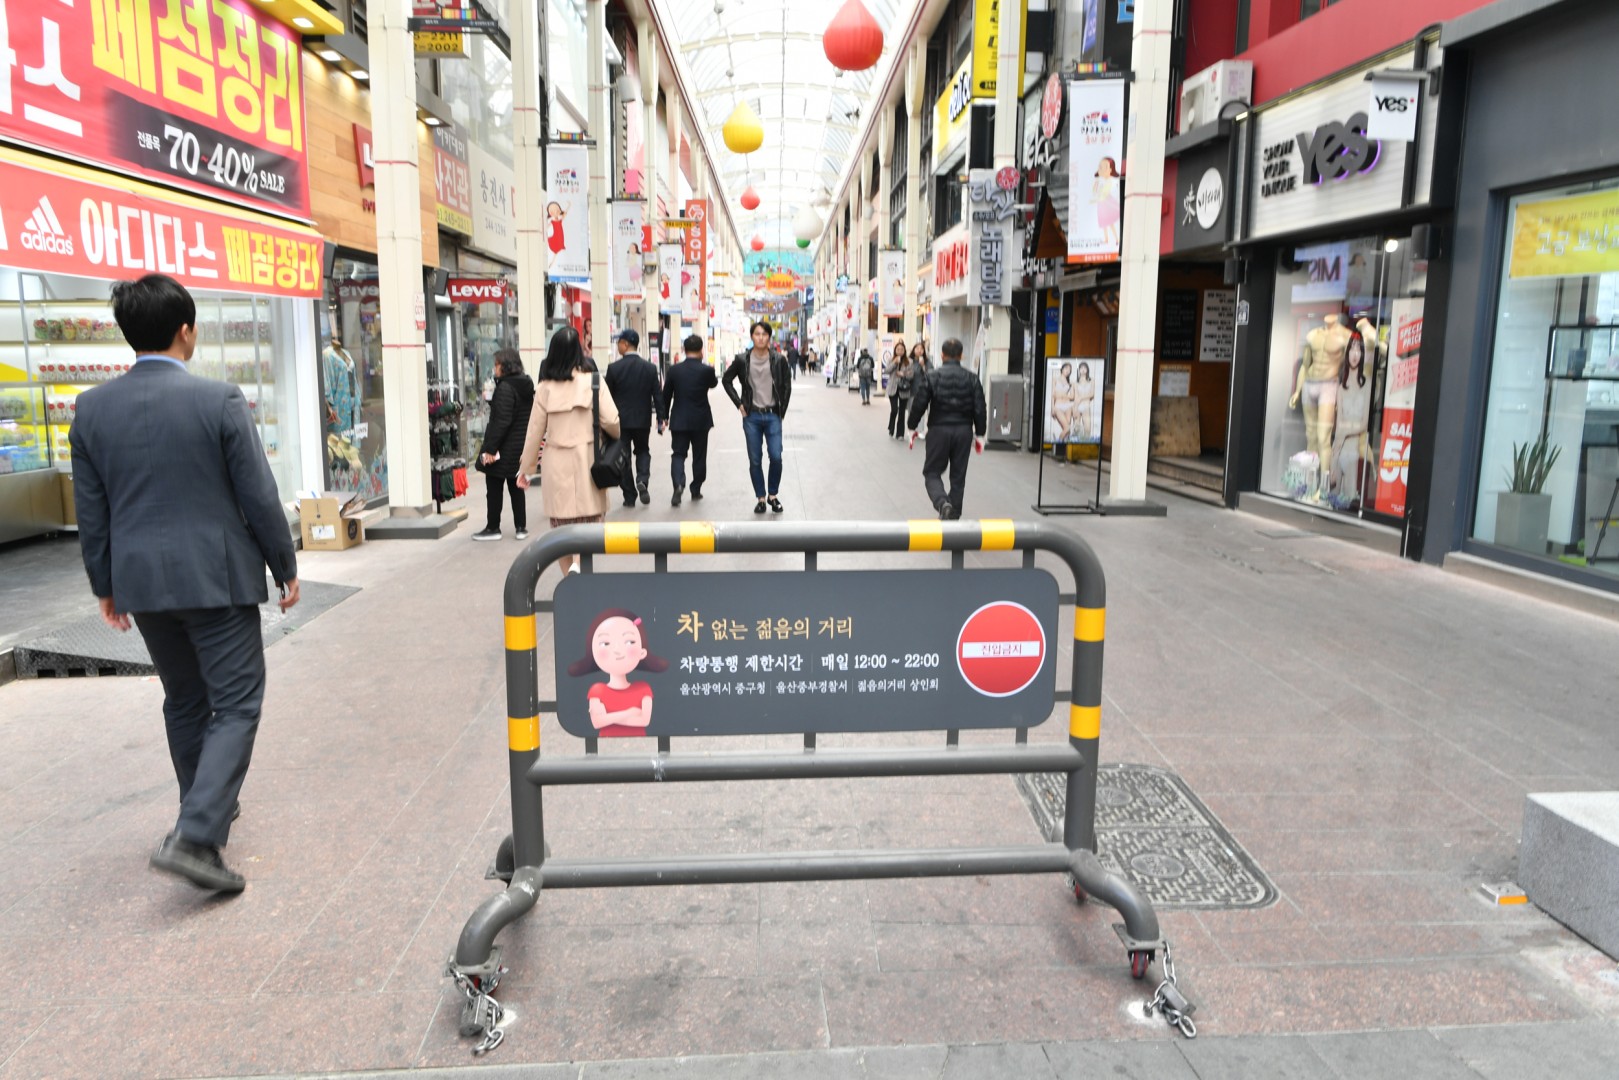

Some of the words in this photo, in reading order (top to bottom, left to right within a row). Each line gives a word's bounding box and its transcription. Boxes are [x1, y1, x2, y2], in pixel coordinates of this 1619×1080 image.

[137, 130, 161, 152] 전품목
[260, 169, 285, 194] SALE
[20, 229, 74, 256] adidas
[80, 198, 218, 280] 아디다스
[1389, 422, 1412, 437] SAL
[676, 610, 704, 643] 차
[711, 617, 749, 641] 없는
[756, 617, 810, 640] 젊음의
[818, 616, 853, 640] 거리
[981, 643, 1023, 656] 진입금지
[679, 654, 739, 674] 차량통행
[745, 654, 804, 672] 제한시간
[821, 653, 849, 671] 매일
[854, 653, 887, 669] 12:00
[904, 652, 940, 669] 22:00
[679, 681, 732, 696] 울산광역시
[735, 680, 766, 695] 중구청
[775, 679, 848, 695] 울산중부경찰서
[857, 678, 906, 693] 젊음의거리
[909, 677, 940, 692] 상인회
